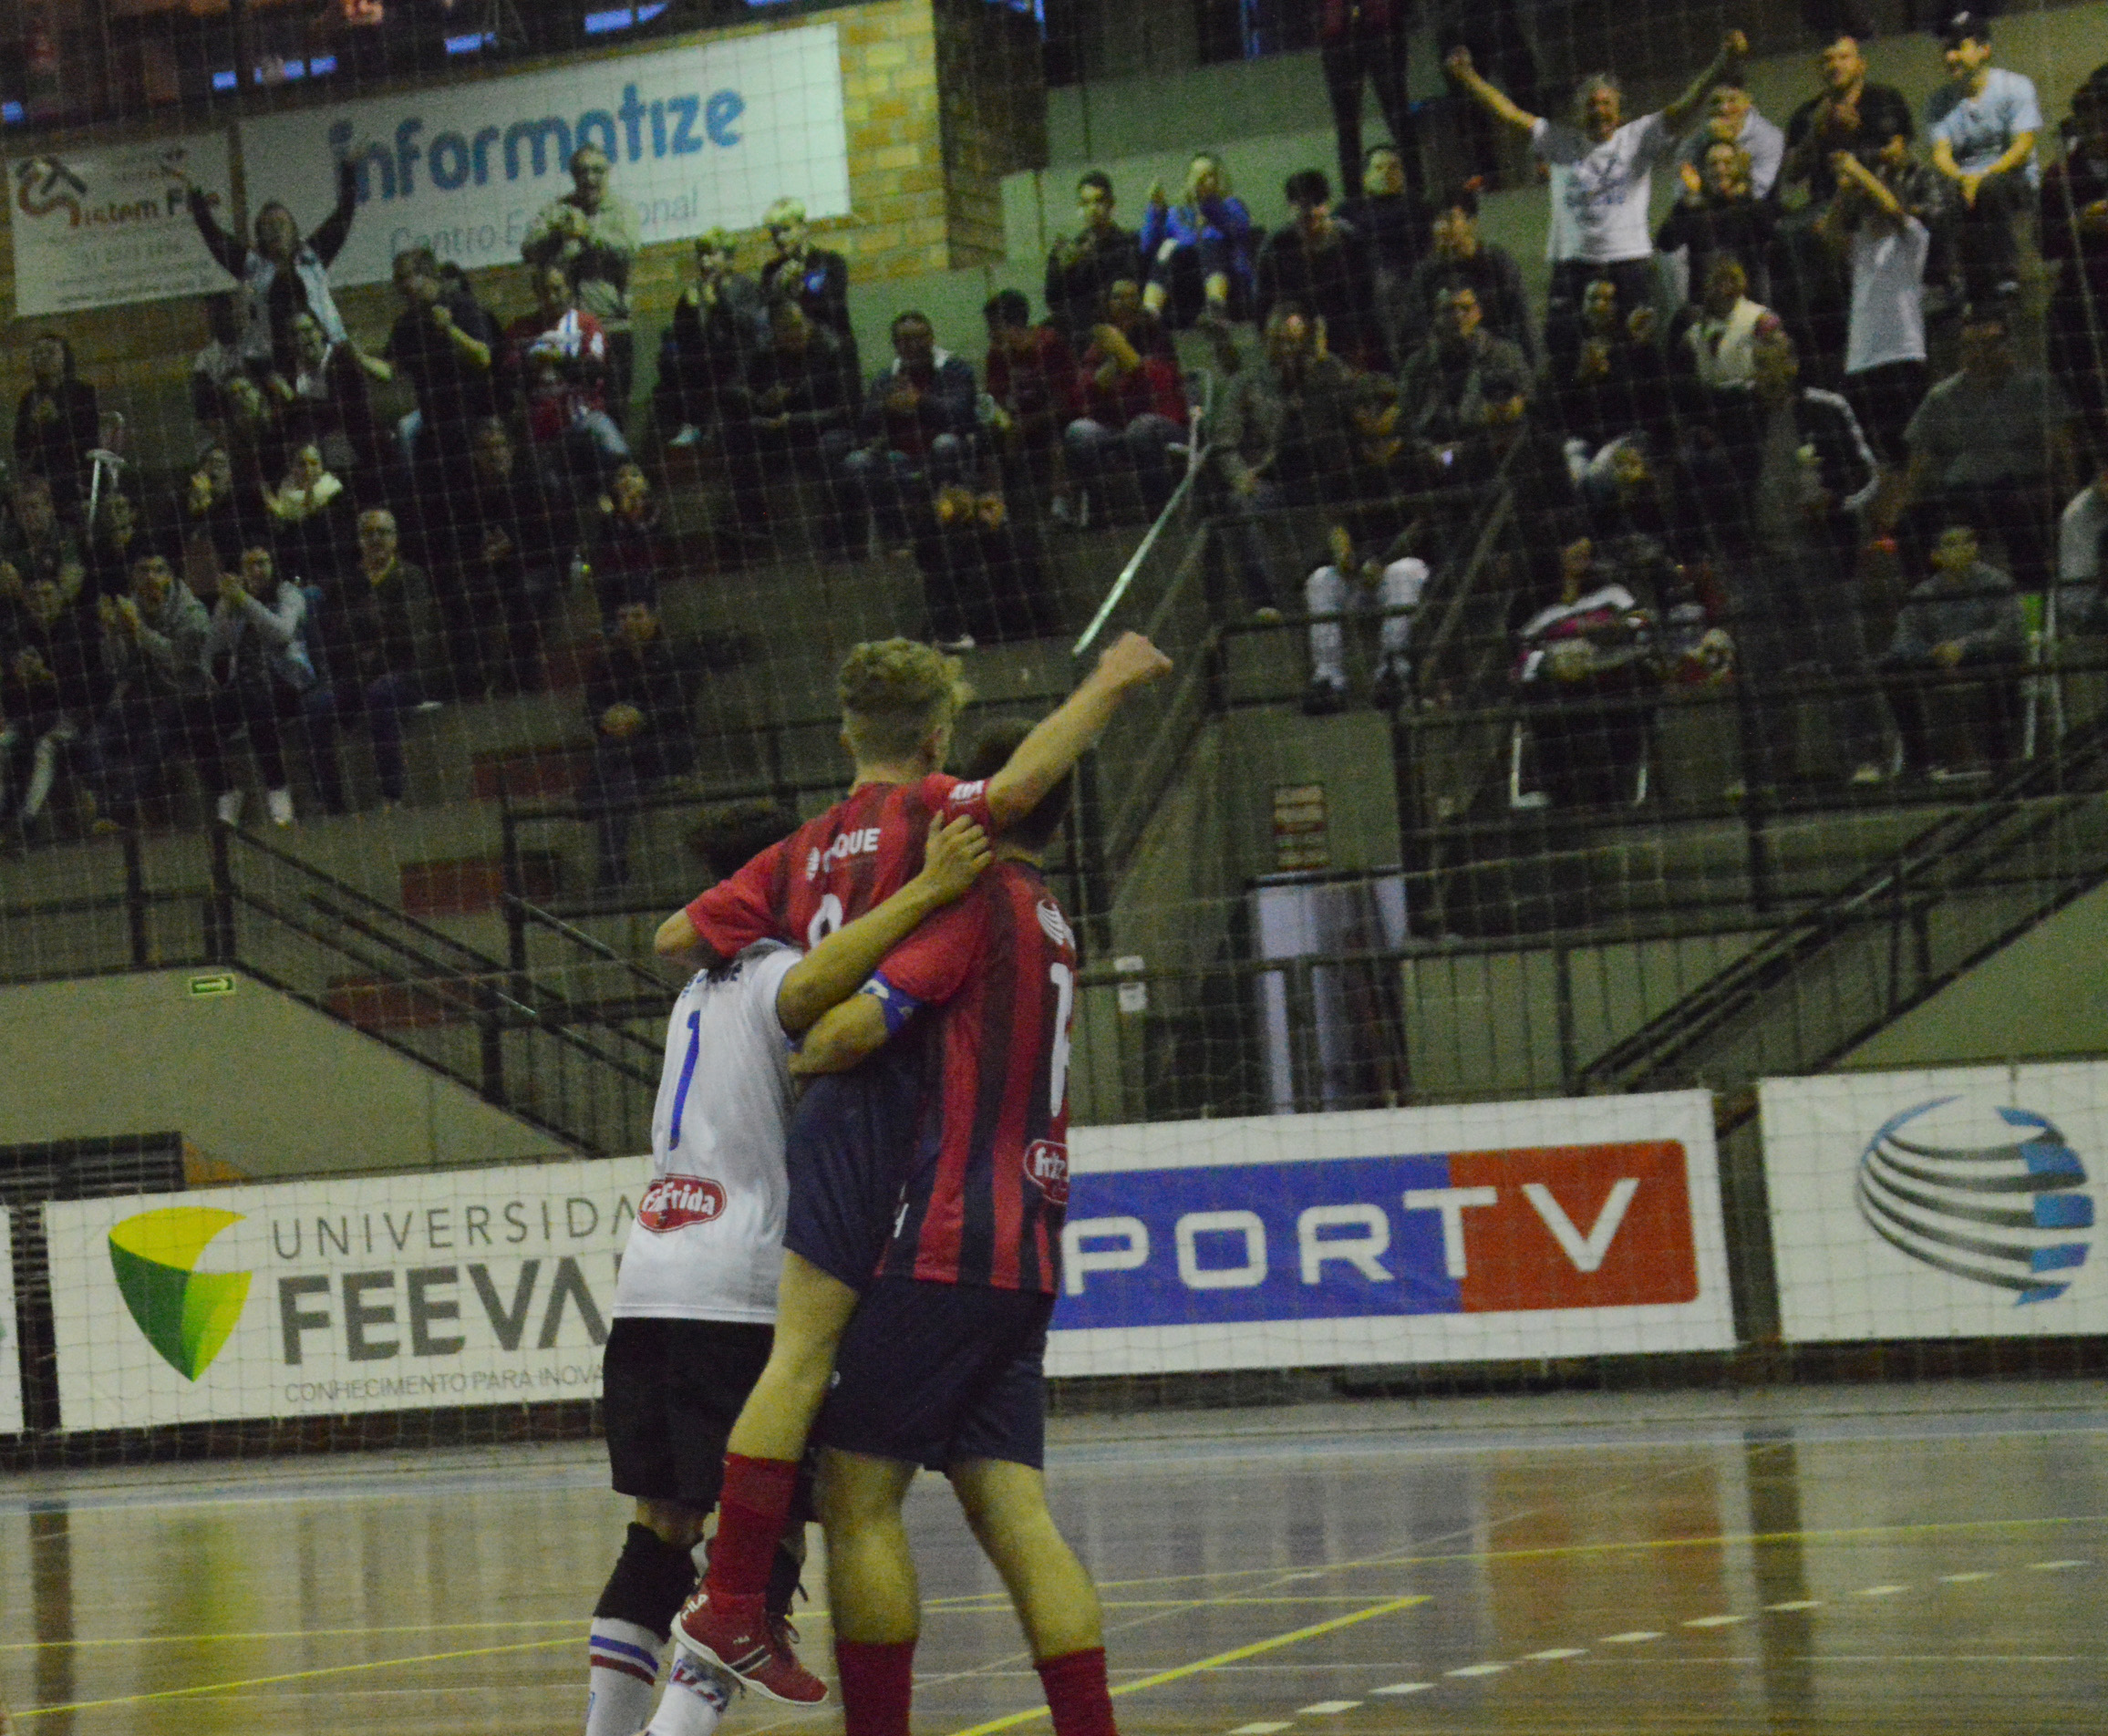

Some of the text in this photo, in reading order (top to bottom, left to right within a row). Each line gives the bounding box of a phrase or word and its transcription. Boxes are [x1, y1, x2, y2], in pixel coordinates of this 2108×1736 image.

[328, 82, 747, 203] informatize
[274, 1194, 635, 1260] UNIVERSIDA
[1061, 1177, 1639, 1297] PORTV
[278, 1253, 625, 1366] FEEVA
[285, 1364, 604, 1403] CONHECIMENTO PARA INOVA
